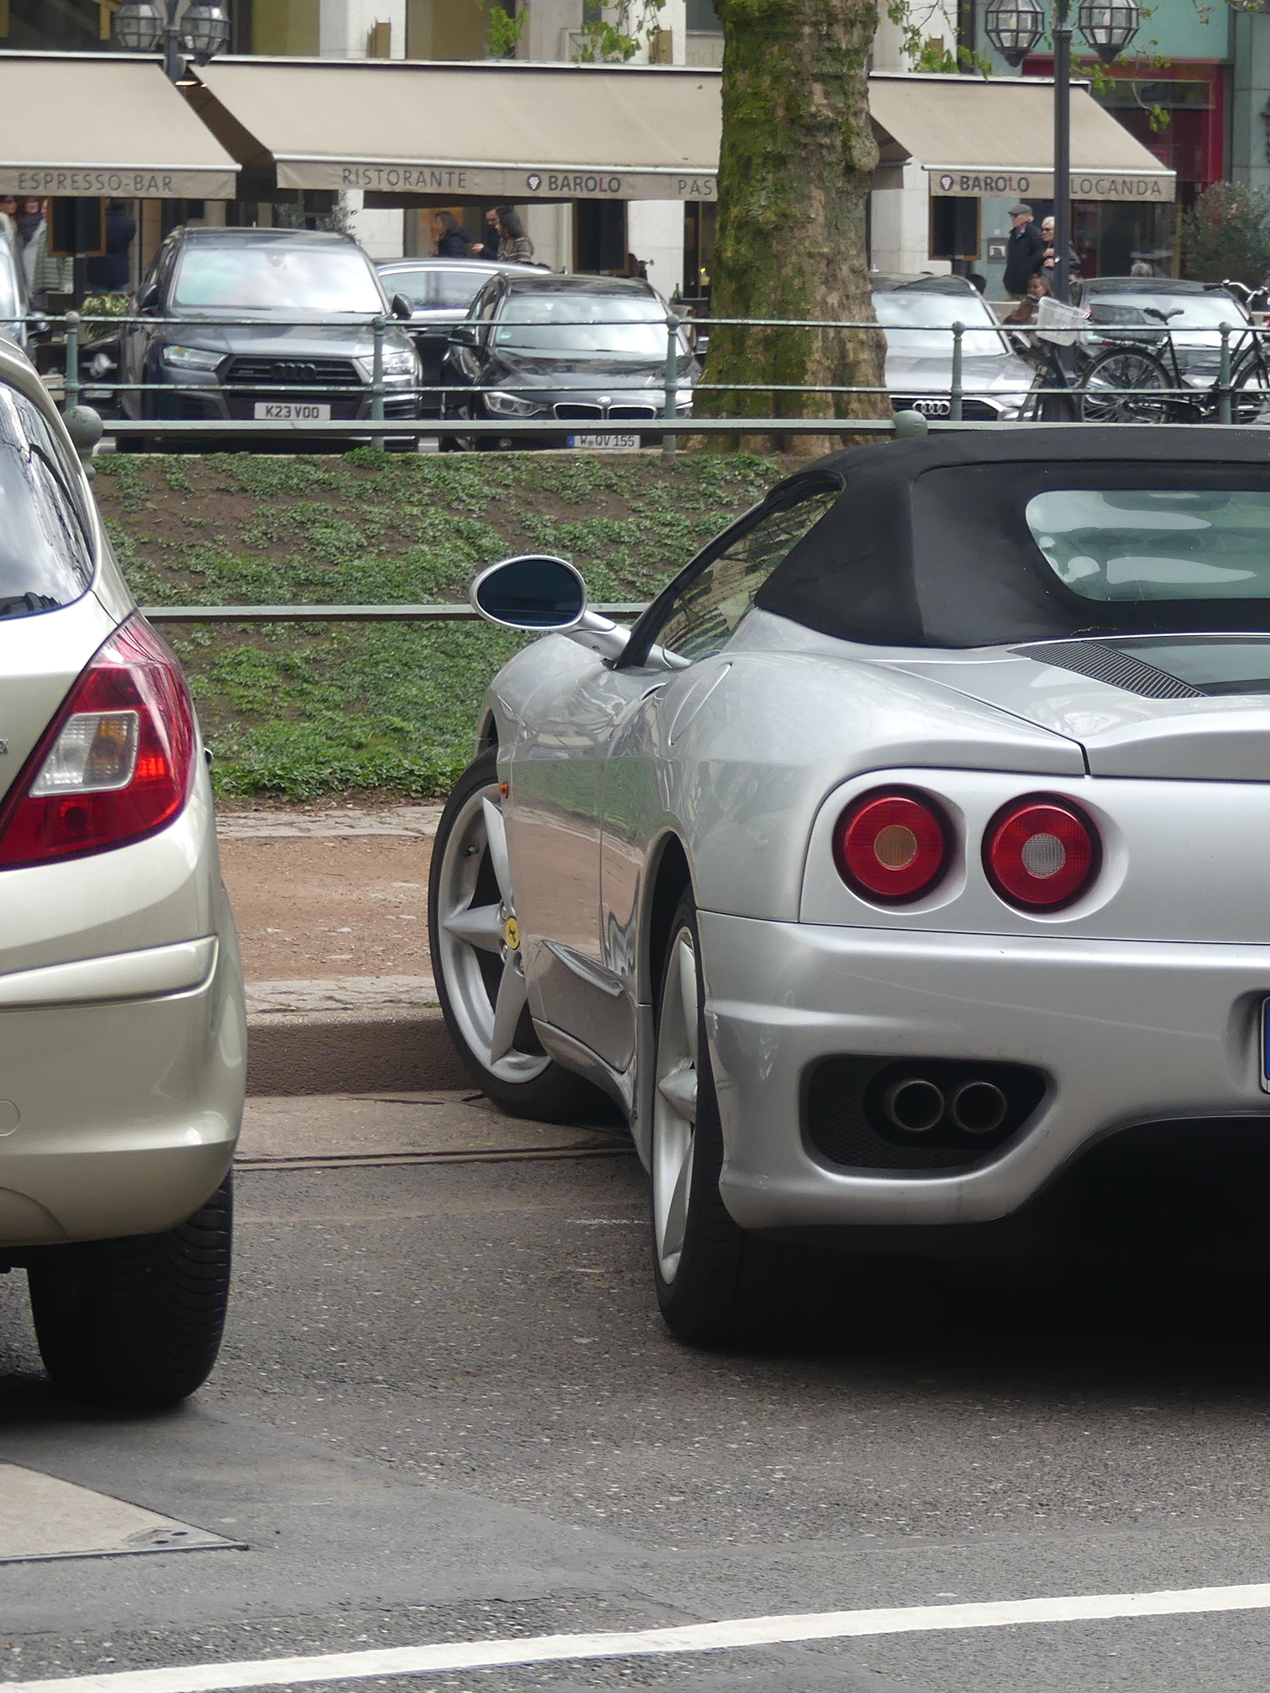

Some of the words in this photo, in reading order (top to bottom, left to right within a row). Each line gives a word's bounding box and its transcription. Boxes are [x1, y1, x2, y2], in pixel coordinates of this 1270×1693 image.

[18, 172, 173, 192] ESPRESSO-BAR
[341, 168, 467, 189] RISTORANTE
[548, 175, 622, 193] BAROLO
[959, 176, 1030, 192] BAROLO
[1070, 178, 1162, 196] LOCANDA
[678, 179, 713, 196] PAS
[265, 405, 291, 418] K23
[580, 435, 587, 445] W
[613, 435, 635, 447] 155
